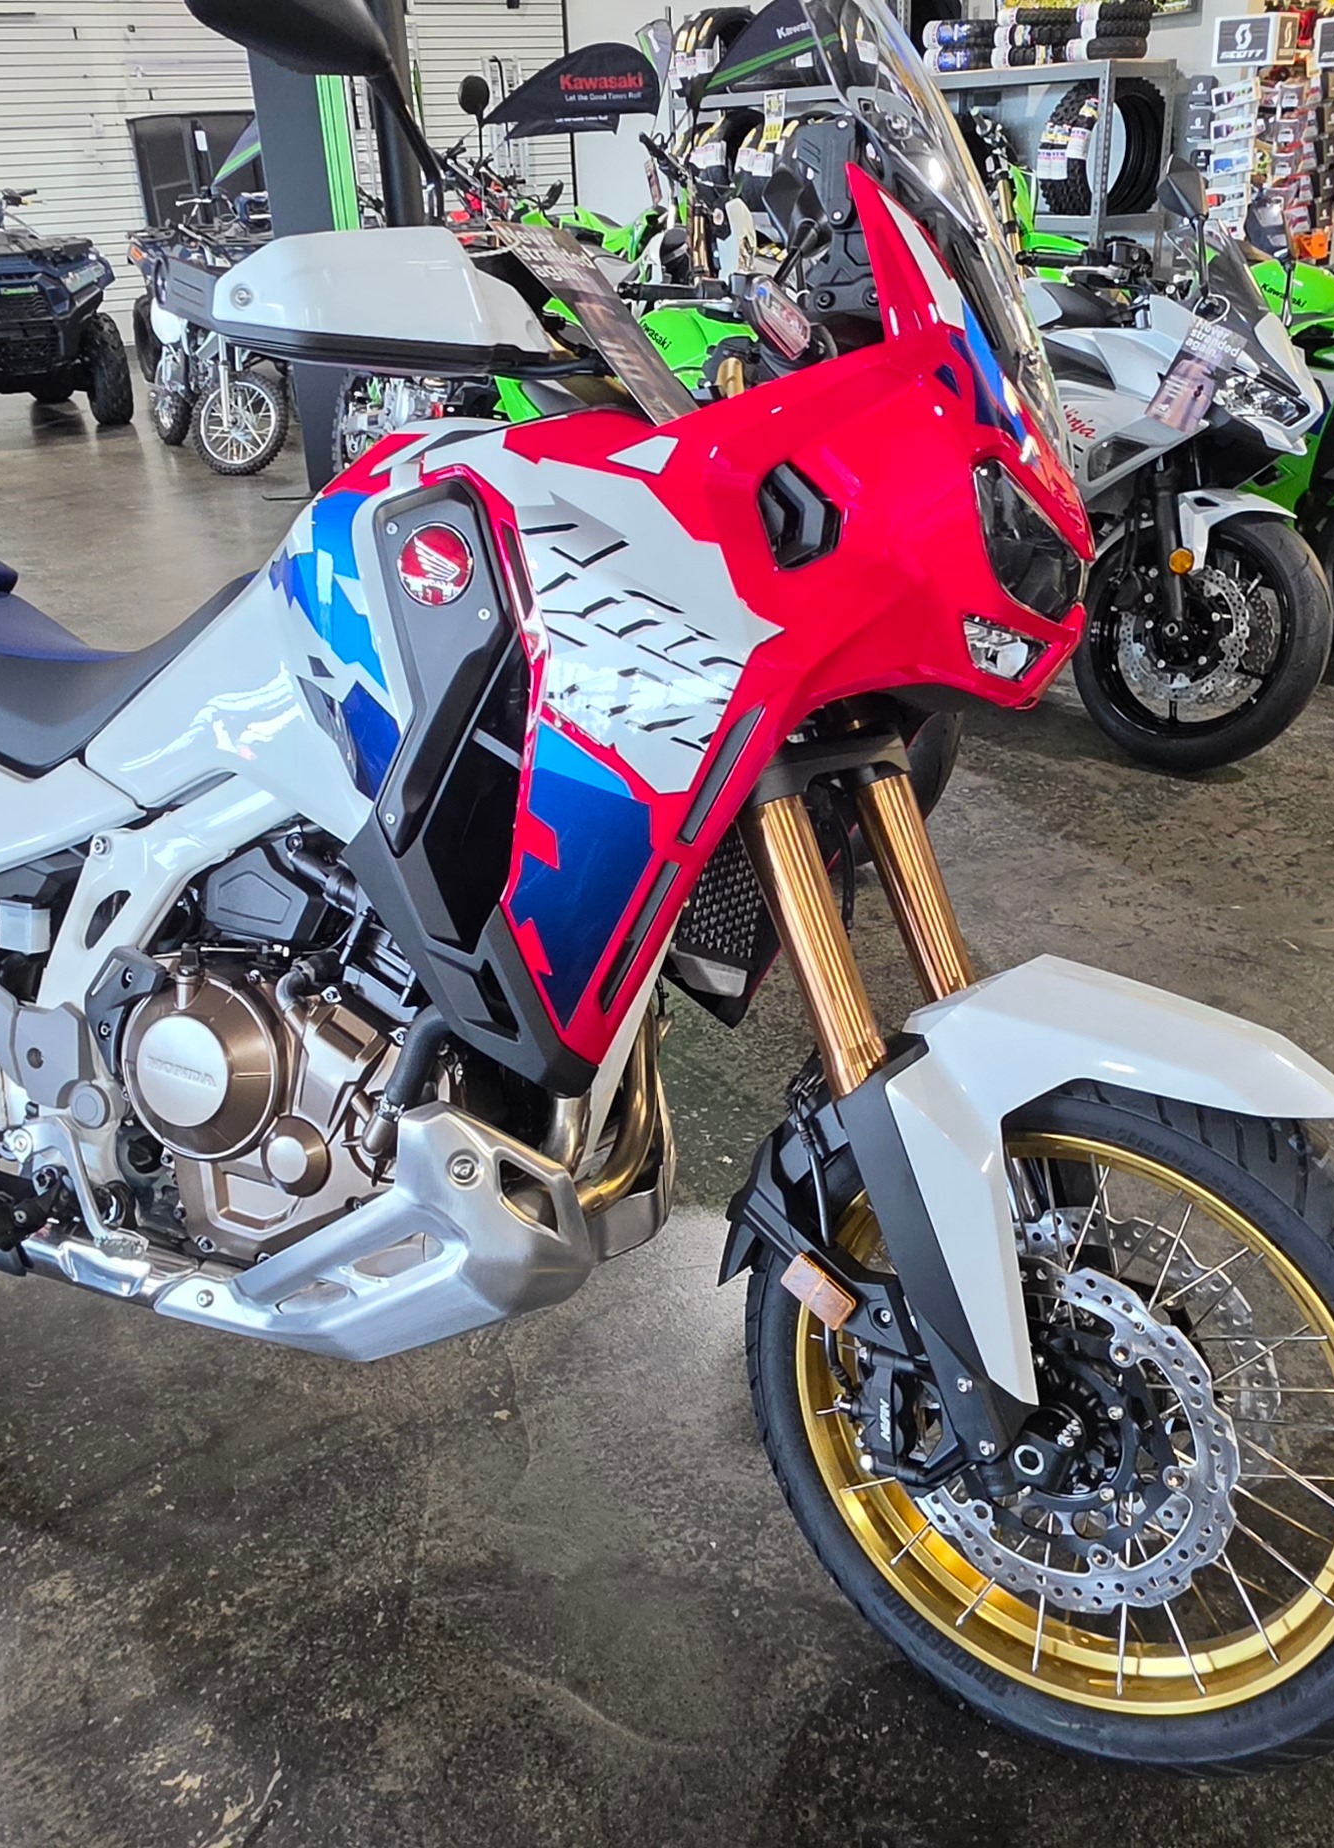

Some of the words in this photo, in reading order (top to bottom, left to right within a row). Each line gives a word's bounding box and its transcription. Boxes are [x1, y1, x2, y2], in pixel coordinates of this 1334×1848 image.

[1220, 49, 1264, 59] SCOTT
[559, 72, 644, 91] Kawasaki
[565, 94, 576, 102] Let
[608, 92, 627, 100] Times
[499, 224, 555, 246] Never
[516, 243, 596, 271] stranded
[1261, 283, 1307, 308] Kawaaki
[640, 317, 673, 351] wasaki
[1190, 328, 1241, 358] stranded
[147, 1055, 218, 1088] HONDA
